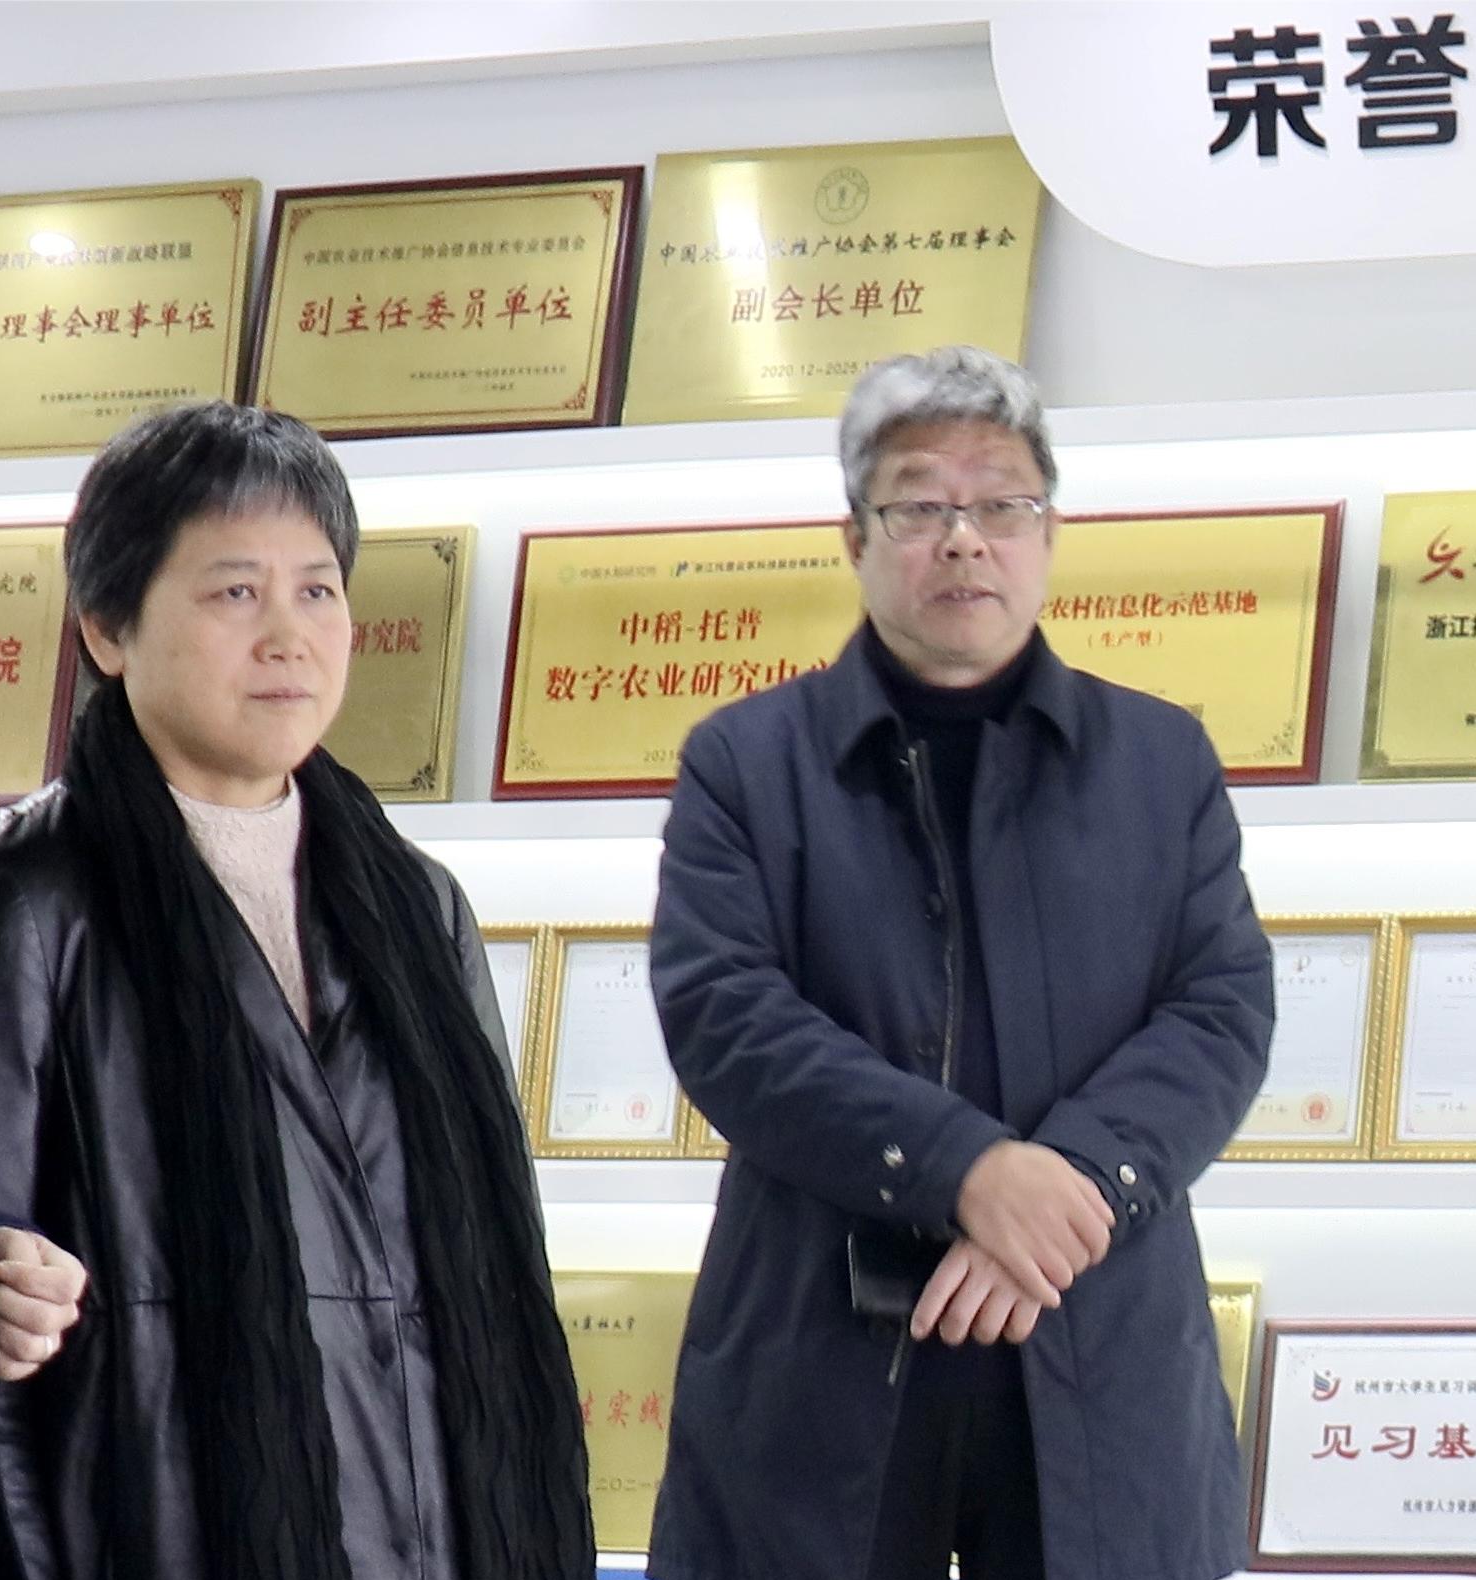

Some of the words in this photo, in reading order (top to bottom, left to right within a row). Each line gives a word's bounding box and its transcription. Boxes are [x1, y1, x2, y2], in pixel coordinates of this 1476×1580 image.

[298, 284, 573, 338] 副主任委员单位
[731, 278, 927, 324] 副会长单位
[620, 607, 763, 646] 中稻-托普
[1041, 590, 1259, 621] 农村信息化示范基地
